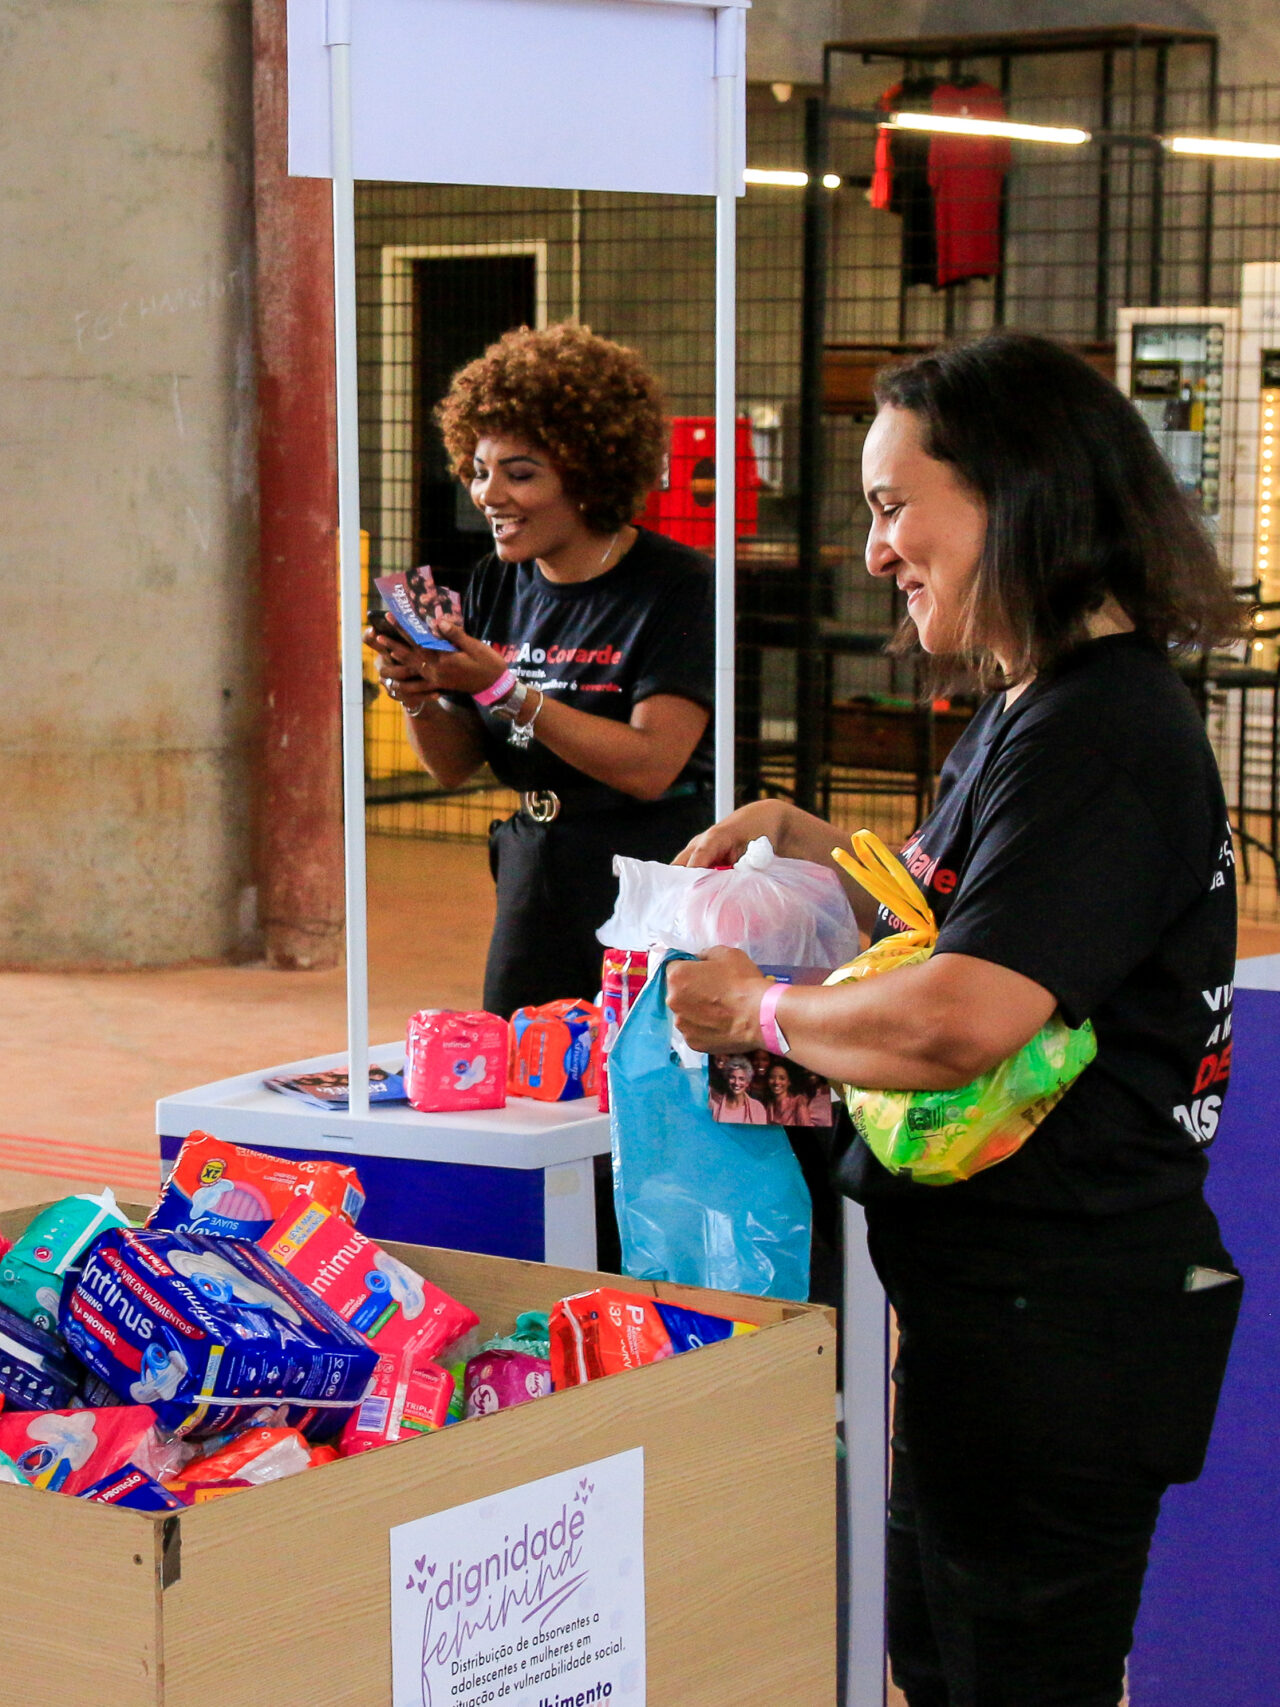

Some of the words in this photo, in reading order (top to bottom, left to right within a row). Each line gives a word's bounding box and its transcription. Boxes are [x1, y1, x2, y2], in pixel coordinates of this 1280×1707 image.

[203, 1168, 221, 1180] 2X
[209, 1217, 240, 1231] SUAVE
[272, 1243, 291, 1257] 16
[305, 1231, 370, 1298] Intimus
[76, 1282, 103, 1312] OTURNO
[133, 1282, 145, 1295] DE
[625, 1304, 645, 1325] P
[405, 1401, 434, 1414] TRIPLA
[101, 1475, 142, 1504] PROTEÇÃO
[434, 1503, 585, 1612] dignidade
[451, 1643, 514, 1677] Distribuição
[516, 1636, 529, 1653] de
[532, 1617, 591, 1645] absorventes
[593, 1613, 600, 1623] a
[450, 1662, 518, 1696] adolescentes
[520, 1659, 527, 1670] e
[529, 1642, 574, 1667] mulheres
[576, 1634, 592, 1649] em
[452, 1690, 495, 1707] ituação
[497, 1681, 511, 1698] de
[513, 1653, 593, 1691] vulnerabilidade
[594, 1636, 626, 1662] social.
